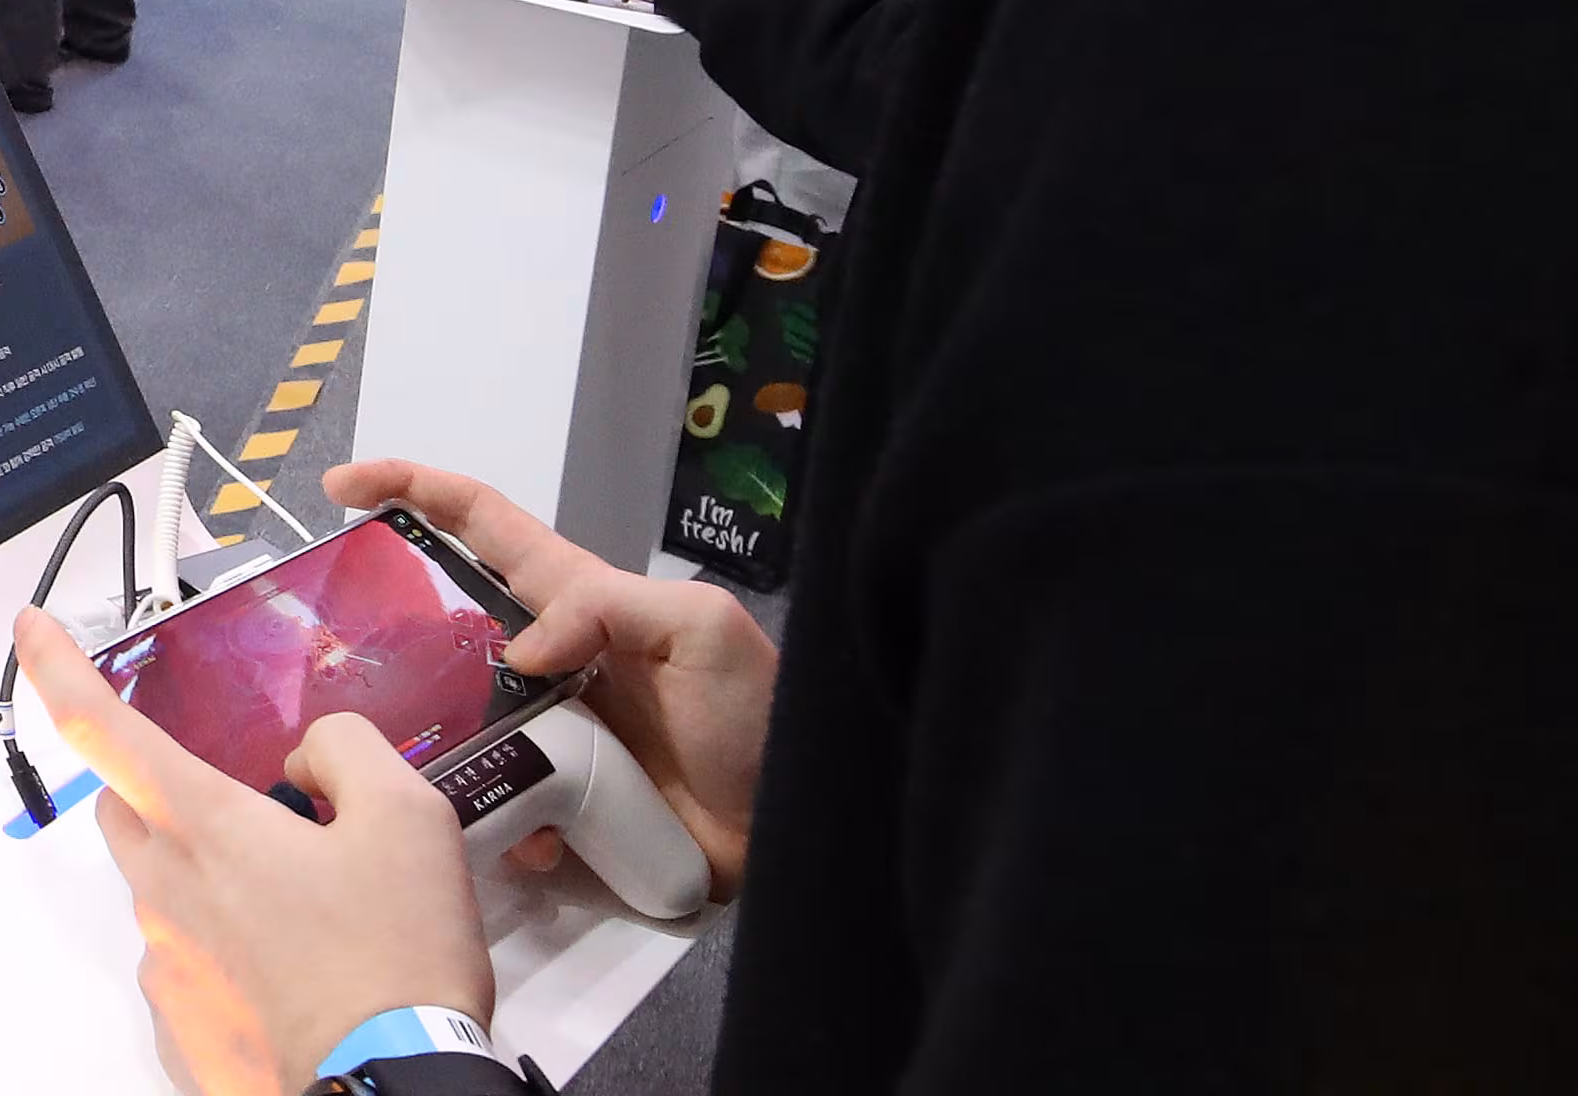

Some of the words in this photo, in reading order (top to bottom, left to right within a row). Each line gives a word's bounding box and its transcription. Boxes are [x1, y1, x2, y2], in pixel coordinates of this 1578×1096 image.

[699, 495, 734, 527] I'm
[679, 508, 760, 557] fresh!
[472, 782, 514, 812] KARMA
